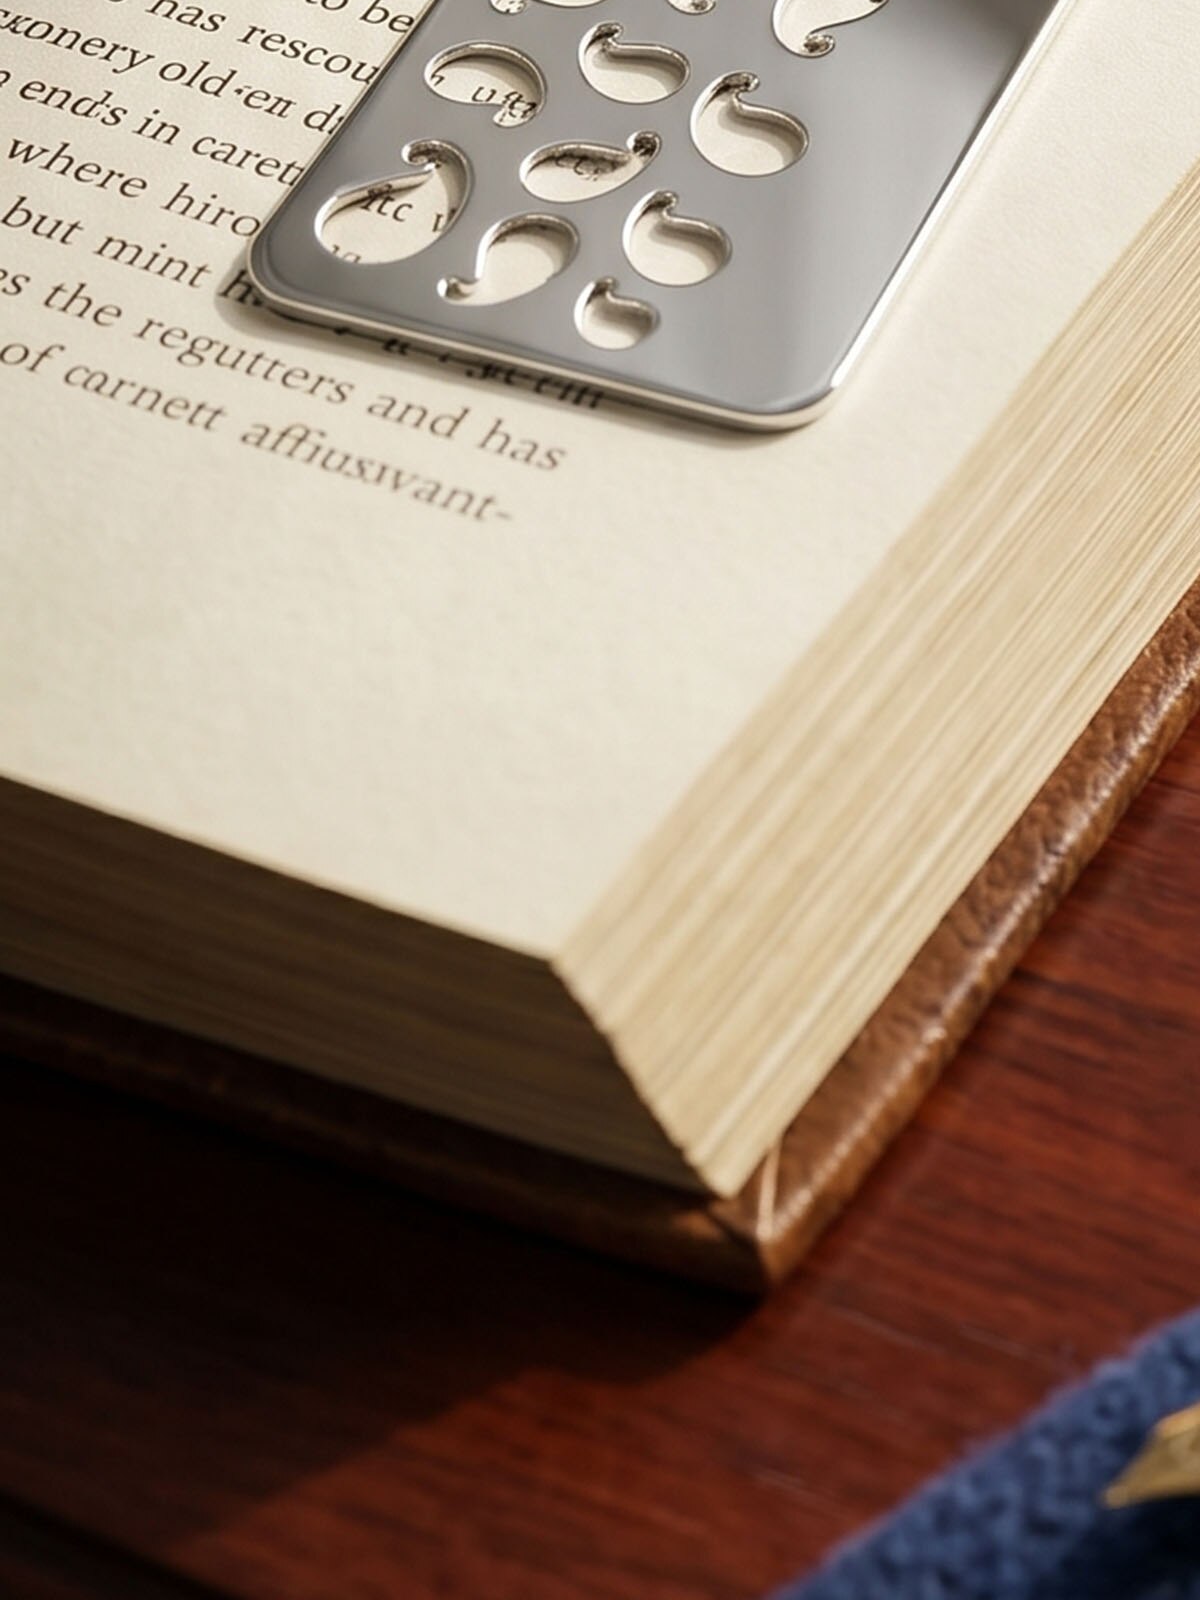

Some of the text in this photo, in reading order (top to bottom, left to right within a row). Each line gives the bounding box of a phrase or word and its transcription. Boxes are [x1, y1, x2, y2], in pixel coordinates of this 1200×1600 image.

[236, 23, 382, 85] rescou
[131, 107, 182, 146] in
[5, 137, 262, 238] where hiro
[0, 194, 85, 246] but
[91, 233, 214, 290] mint
[0, 341, 66, 374] of
[42, 281, 123, 328] the
[132, 316, 356, 405] regutters
[366, 391, 471, 442] and
[475, 417, 568, 474] has
